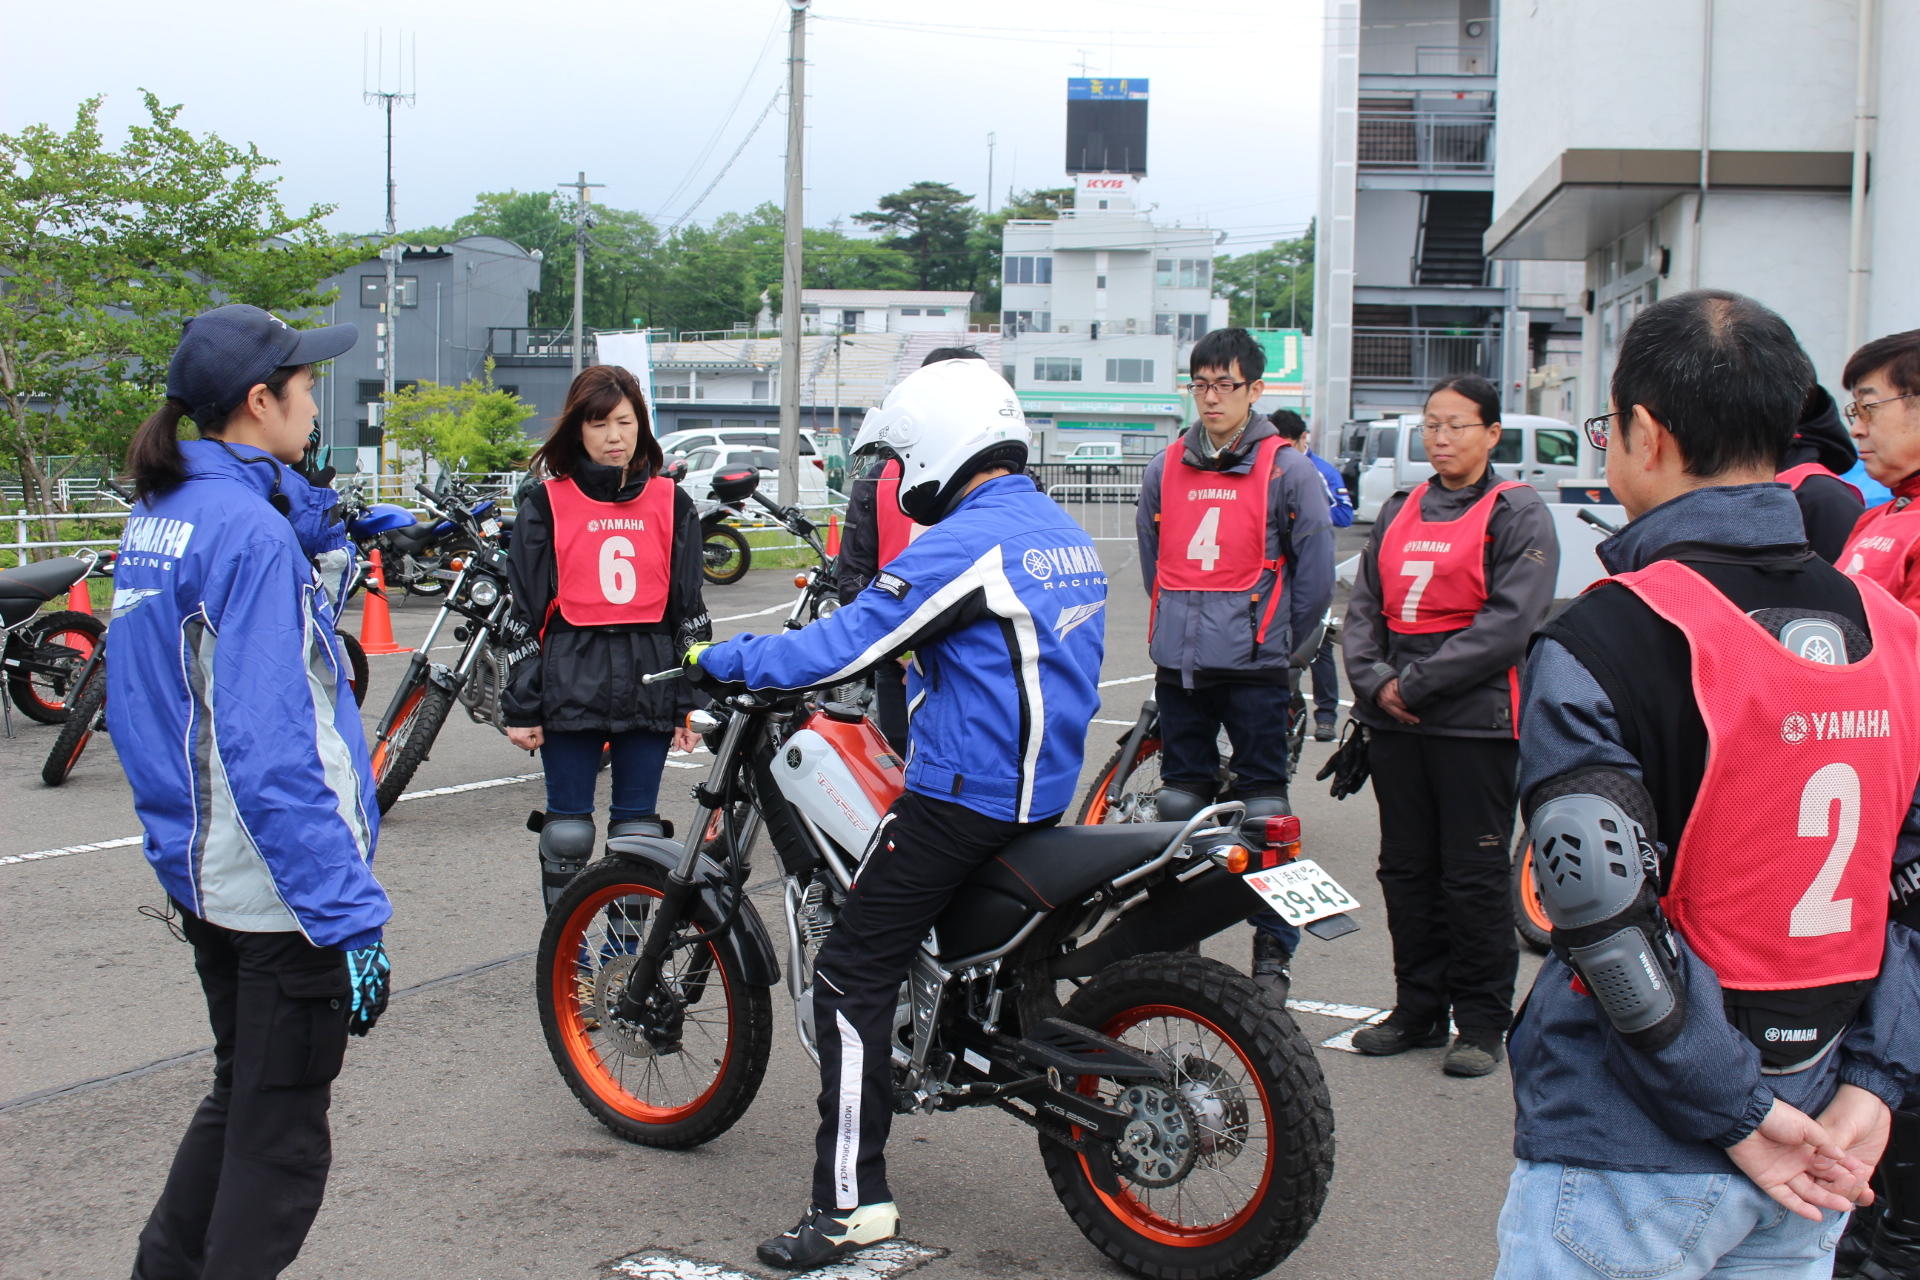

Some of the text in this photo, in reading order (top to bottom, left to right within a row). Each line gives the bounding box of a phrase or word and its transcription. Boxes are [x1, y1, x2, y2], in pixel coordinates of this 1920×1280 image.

[1198, 488, 1237, 500] YAMAHA
[124, 516, 194, 559] YAMAHA
[600, 518, 645, 531] YAMAHA
[1187, 507, 1221, 571] 4
[1411, 540, 1451, 553] YAMAHA
[598, 535, 637, 605] 6
[1043, 577, 1108, 590] RACING
[1400, 560, 1435, 623] 7
[1811, 709, 1891, 741] YAMAHA
[1788, 762, 1862, 938] 2
[1271, 881, 1349, 919] 39-43
[1639, 951, 1657, 983] YAMAHA
[1780, 1028, 1818, 1042] YAMAHA
[1043, 1100, 1065, 1116] XG
[840, 1105, 853, 1181] MOTOPERFORMANCE
